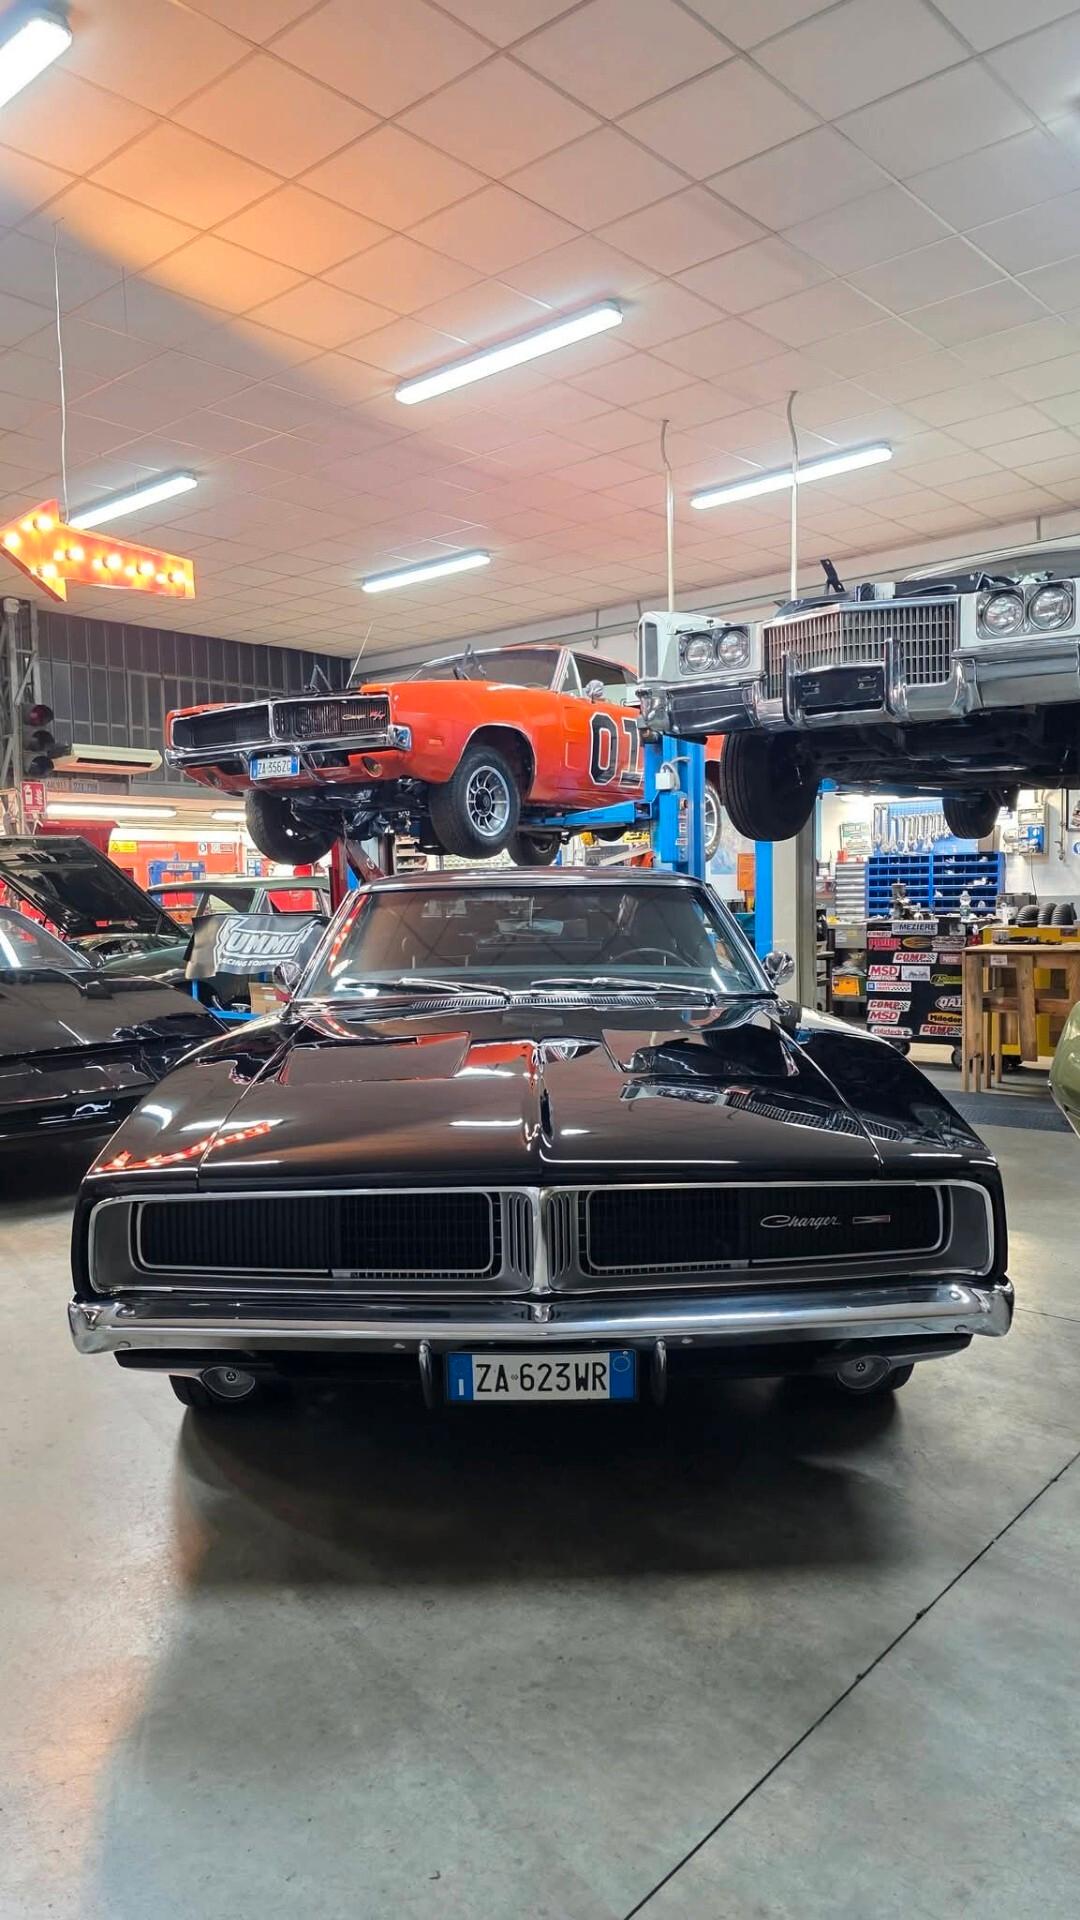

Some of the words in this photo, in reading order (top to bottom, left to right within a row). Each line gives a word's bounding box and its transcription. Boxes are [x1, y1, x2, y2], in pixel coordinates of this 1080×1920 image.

[589, 712, 644, 789] 01
[900, 923, 936, 931] MEZIERE
[216, 916, 314, 966] SUMMIT
[896, 953, 927, 961] COMP
[870, 966, 898, 976] MSD
[870, 1000, 901, 1009] COMP
[870, 1011, 899, 1020] MSD
[922, 1025, 954, 1034] COMP
[760, 1214, 842, 1230] Charger
[476, 1364, 509, 1393] ZA
[519, 1362, 607, 1392] 623WR
